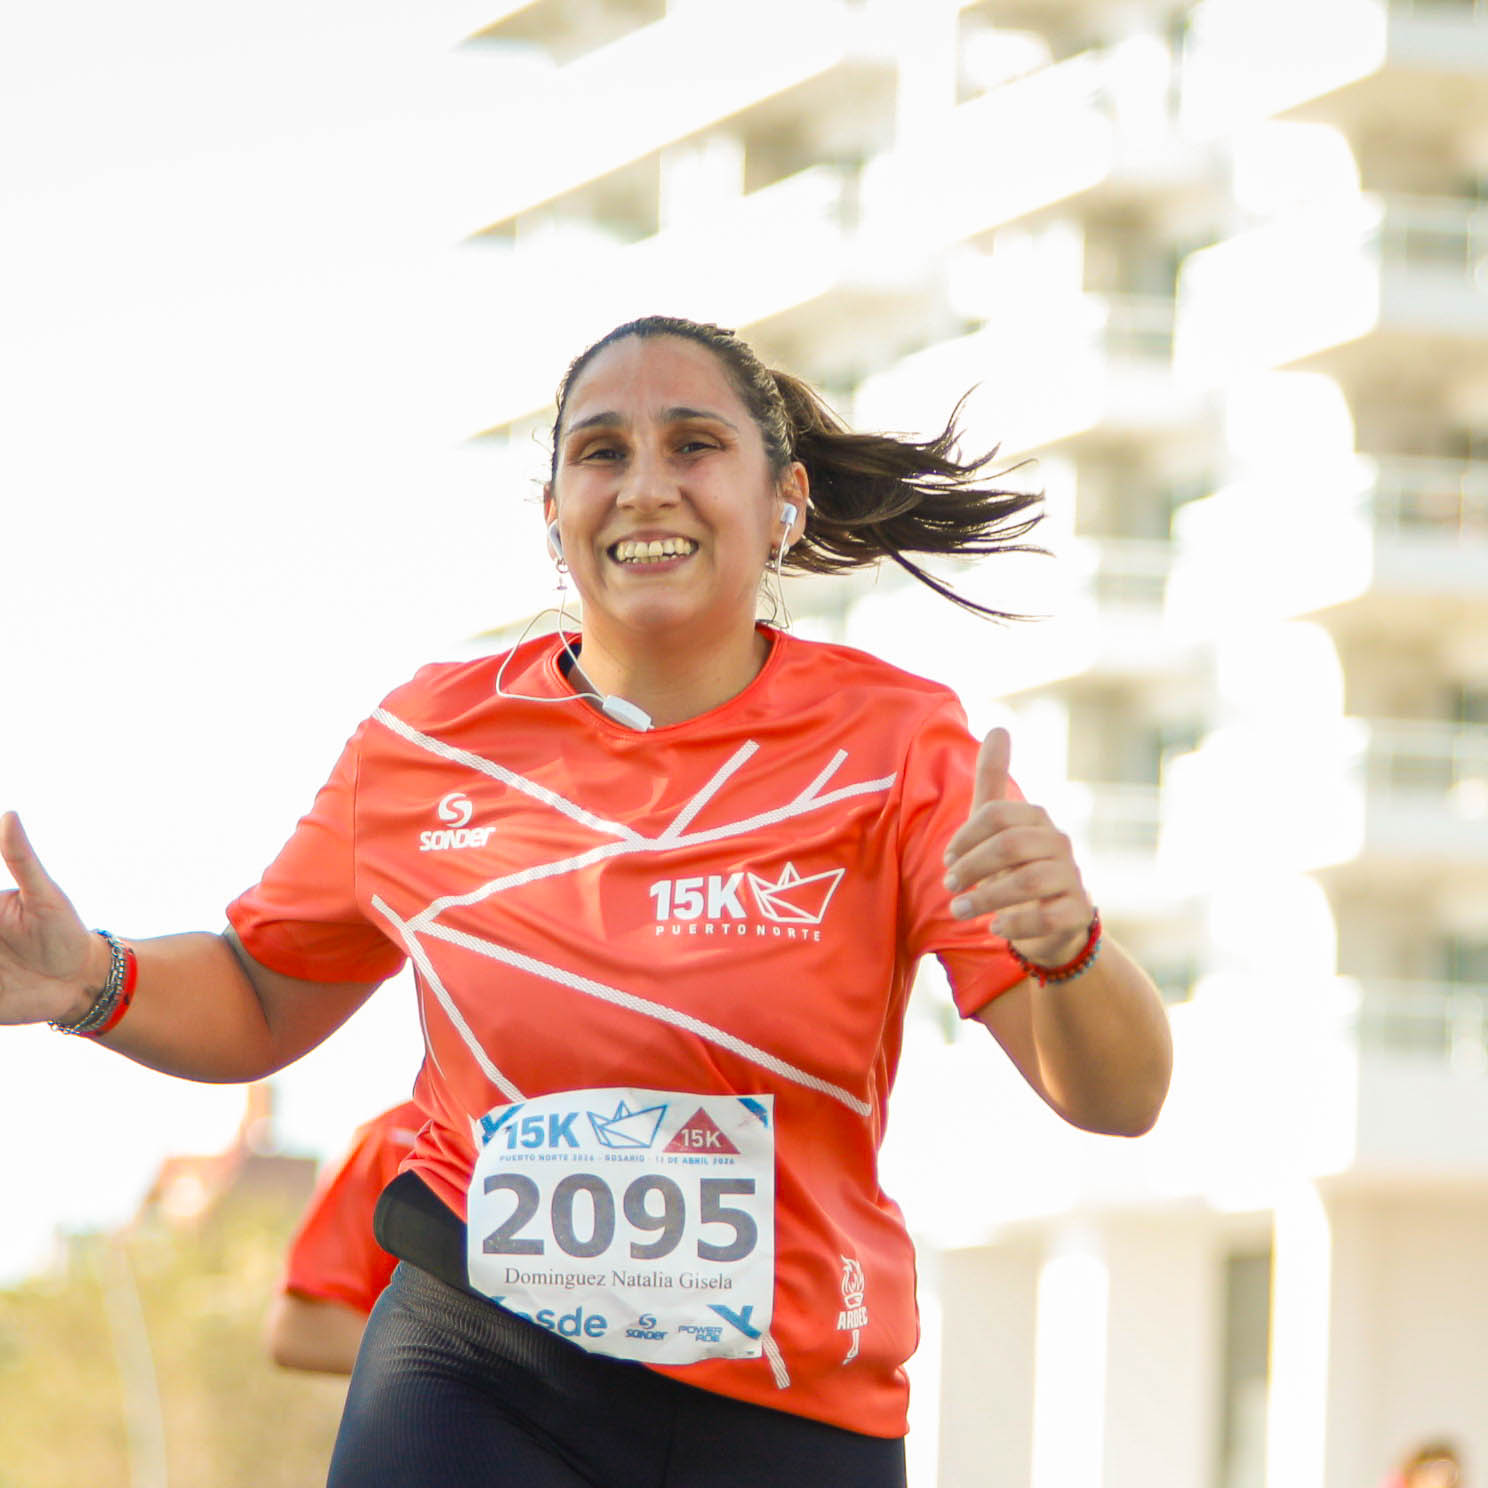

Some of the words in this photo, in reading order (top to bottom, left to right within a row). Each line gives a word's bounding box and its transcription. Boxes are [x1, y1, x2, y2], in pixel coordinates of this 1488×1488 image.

[649, 872, 747, 921] 15K
[655, 923, 747, 936] PUERTO
[756, 925, 821, 942] NORTE
[505, 1112, 580, 1149] 15K
[679, 1128, 722, 1149] 15K
[482, 1173, 758, 1262] 2095
[504, 1267, 606, 1289] Dominguez
[611, 1270, 673, 1288] Natalia
[678, 1272, 733, 1289] Gisela
[515, 1305, 608, 1337] sde
[678, 1325, 723, 1336] POWER
